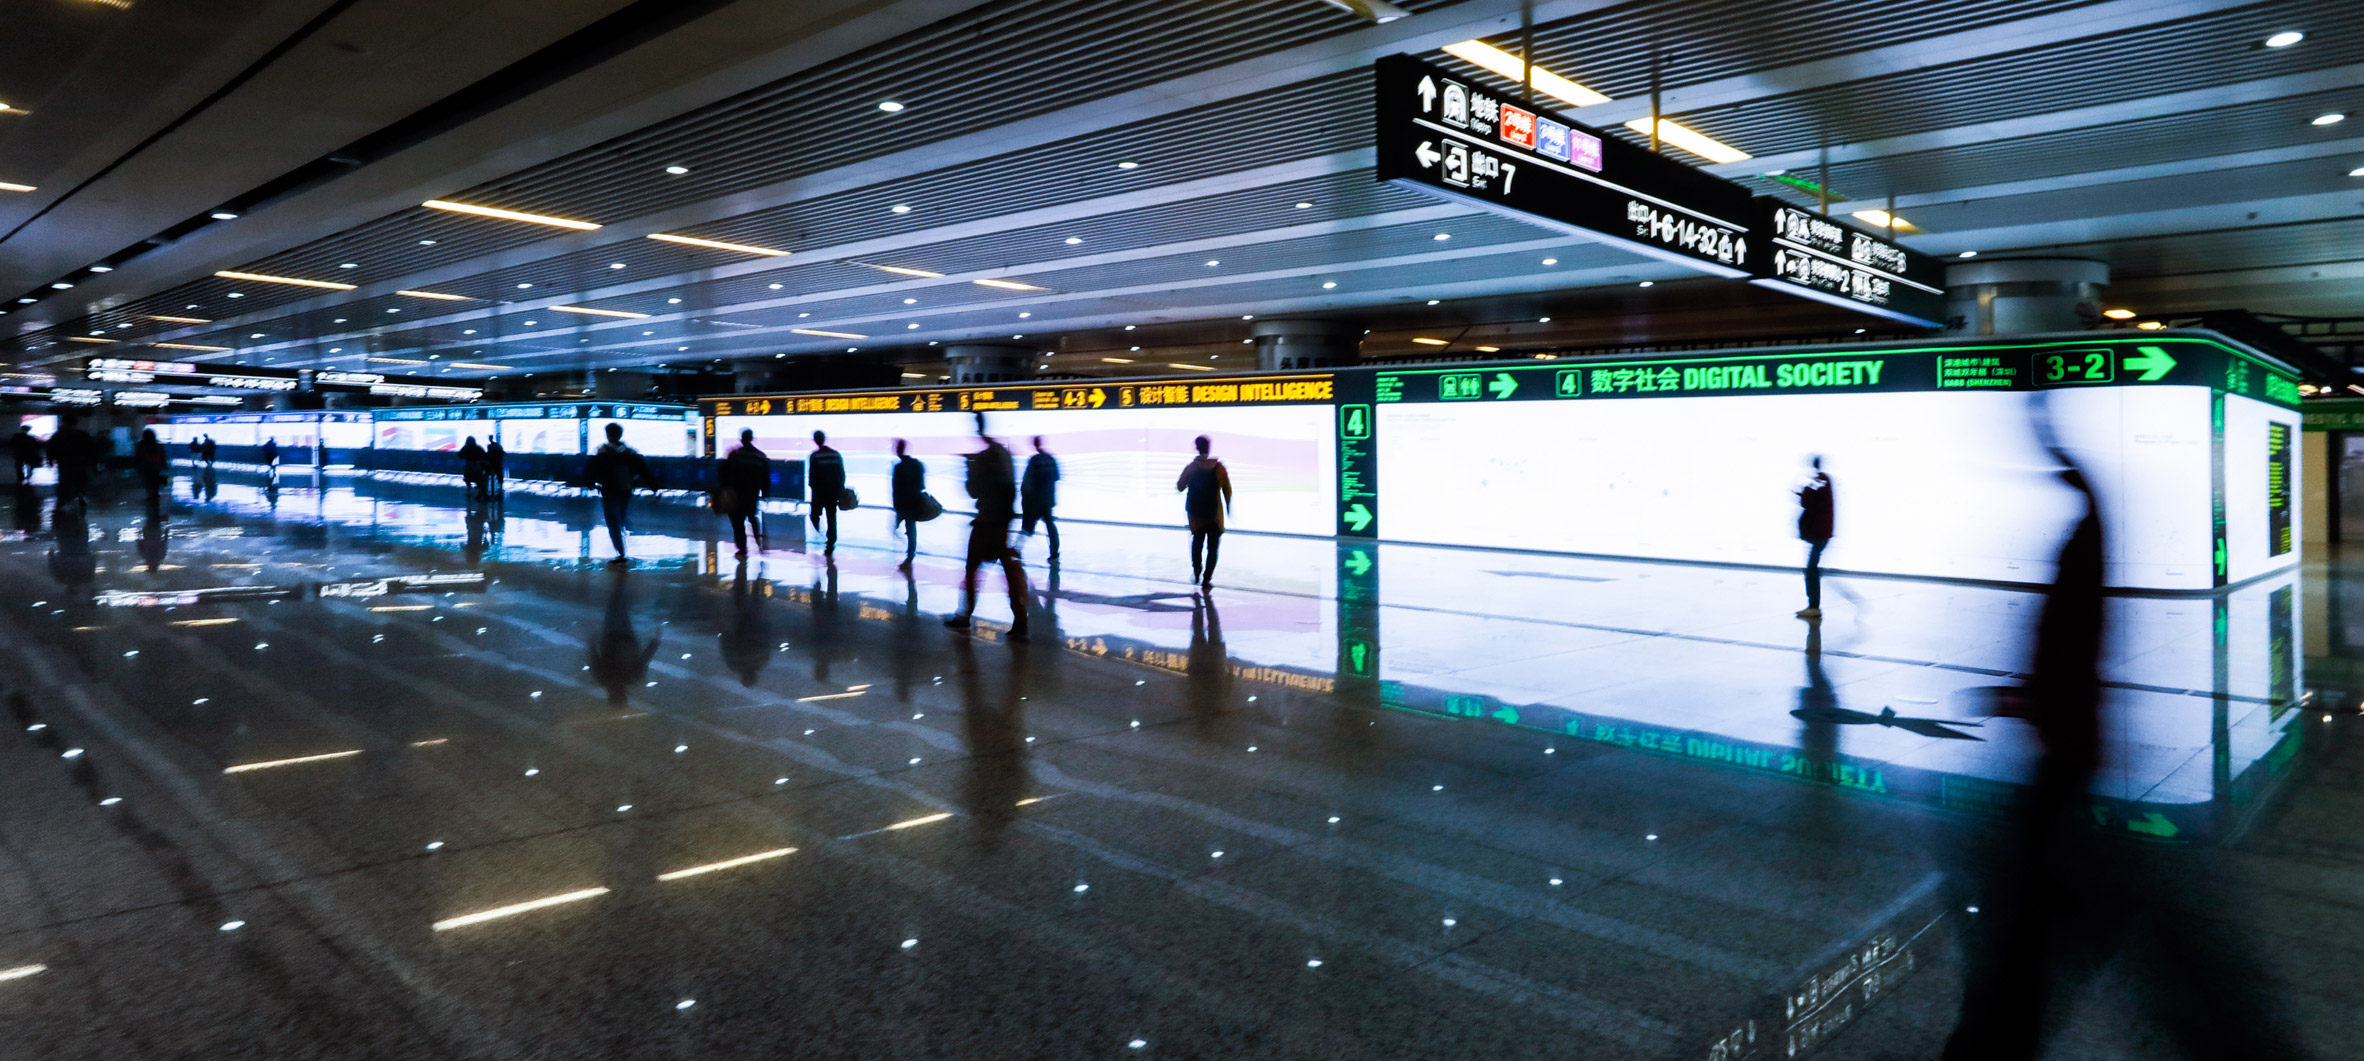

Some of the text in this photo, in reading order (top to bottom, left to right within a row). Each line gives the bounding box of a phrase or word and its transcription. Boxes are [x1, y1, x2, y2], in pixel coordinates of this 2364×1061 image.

[1500, 163, 1516, 195] 7
[1562, 360, 1884, 394] 4 数字社会 DIGITAL SOCIETY
[2046, 353, 2105, 380] 3-2
[1063, 391, 1087, 407] 4-3
[1121, 380, 1334, 405] 5 设计智能 DESIGN INTELLIGENCE
[1347, 409, 1364, 436] 4
